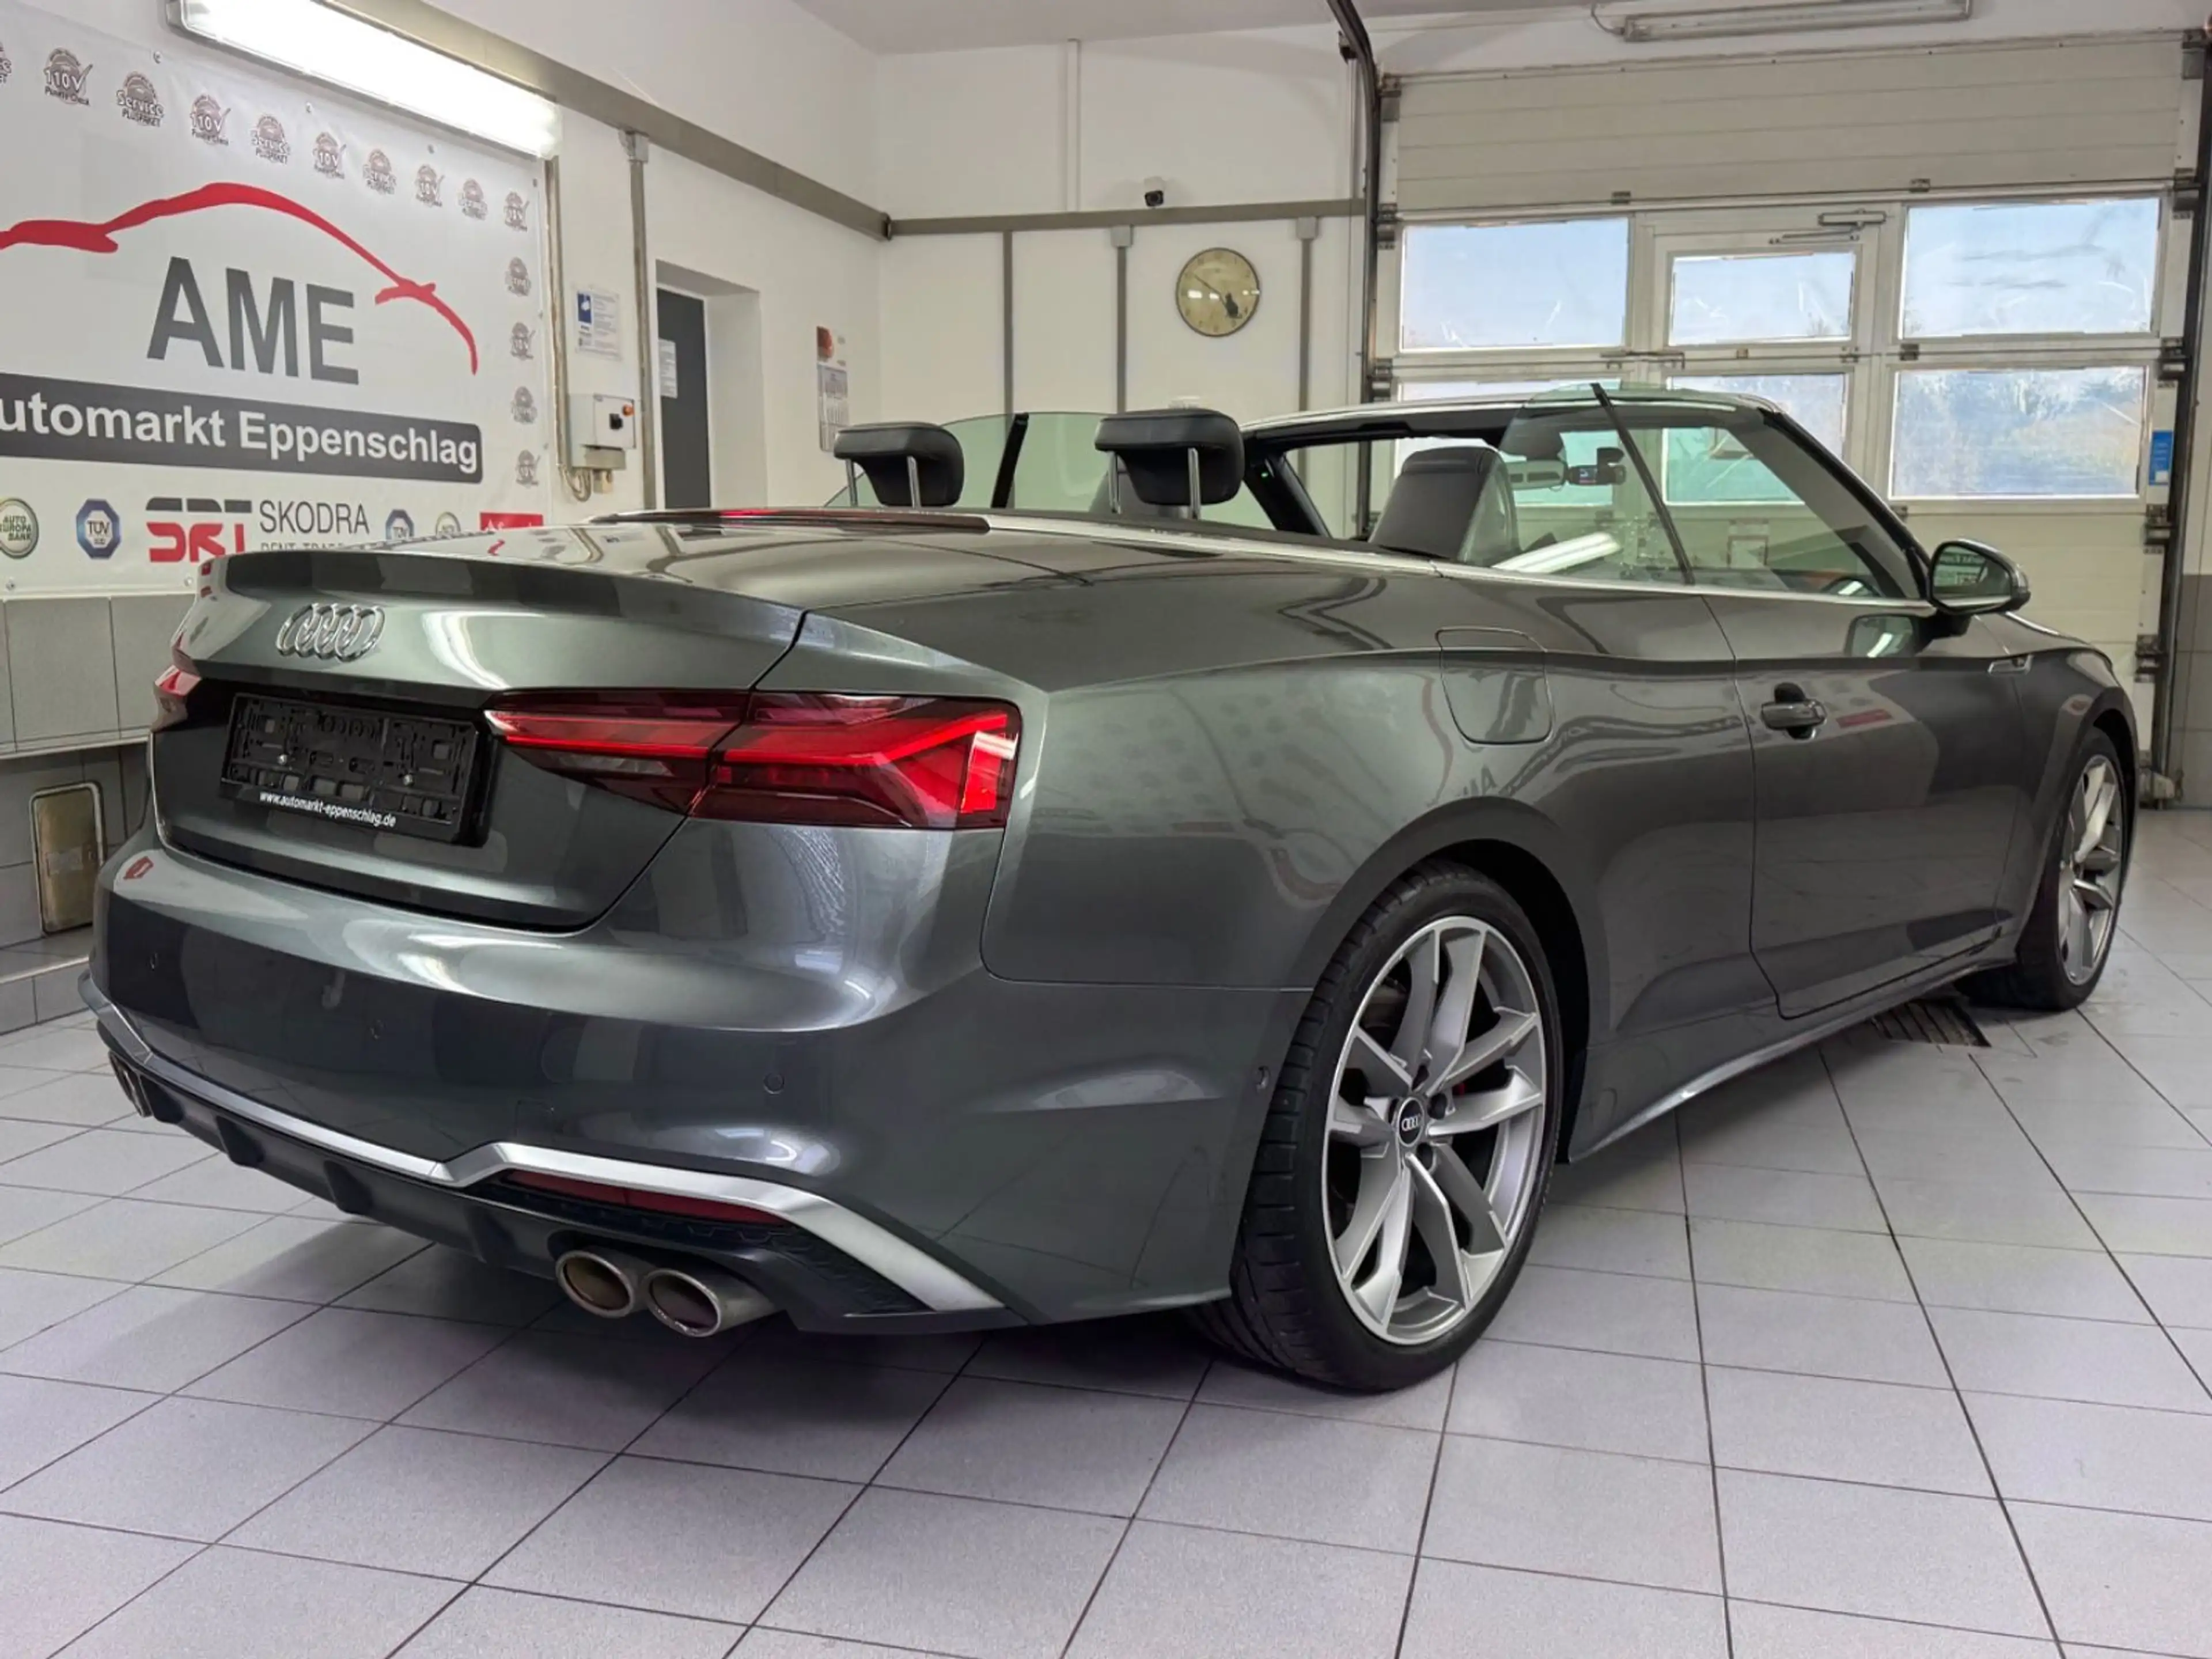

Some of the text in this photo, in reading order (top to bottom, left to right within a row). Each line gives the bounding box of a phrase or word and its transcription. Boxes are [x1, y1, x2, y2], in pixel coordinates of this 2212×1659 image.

[146, 255, 359, 385] AME
[238, 410, 477, 474] Eppenschlag
[259, 500, 370, 534] SKODRA
[260, 791, 396, 827] www.automarkt-eppenschlag.de
